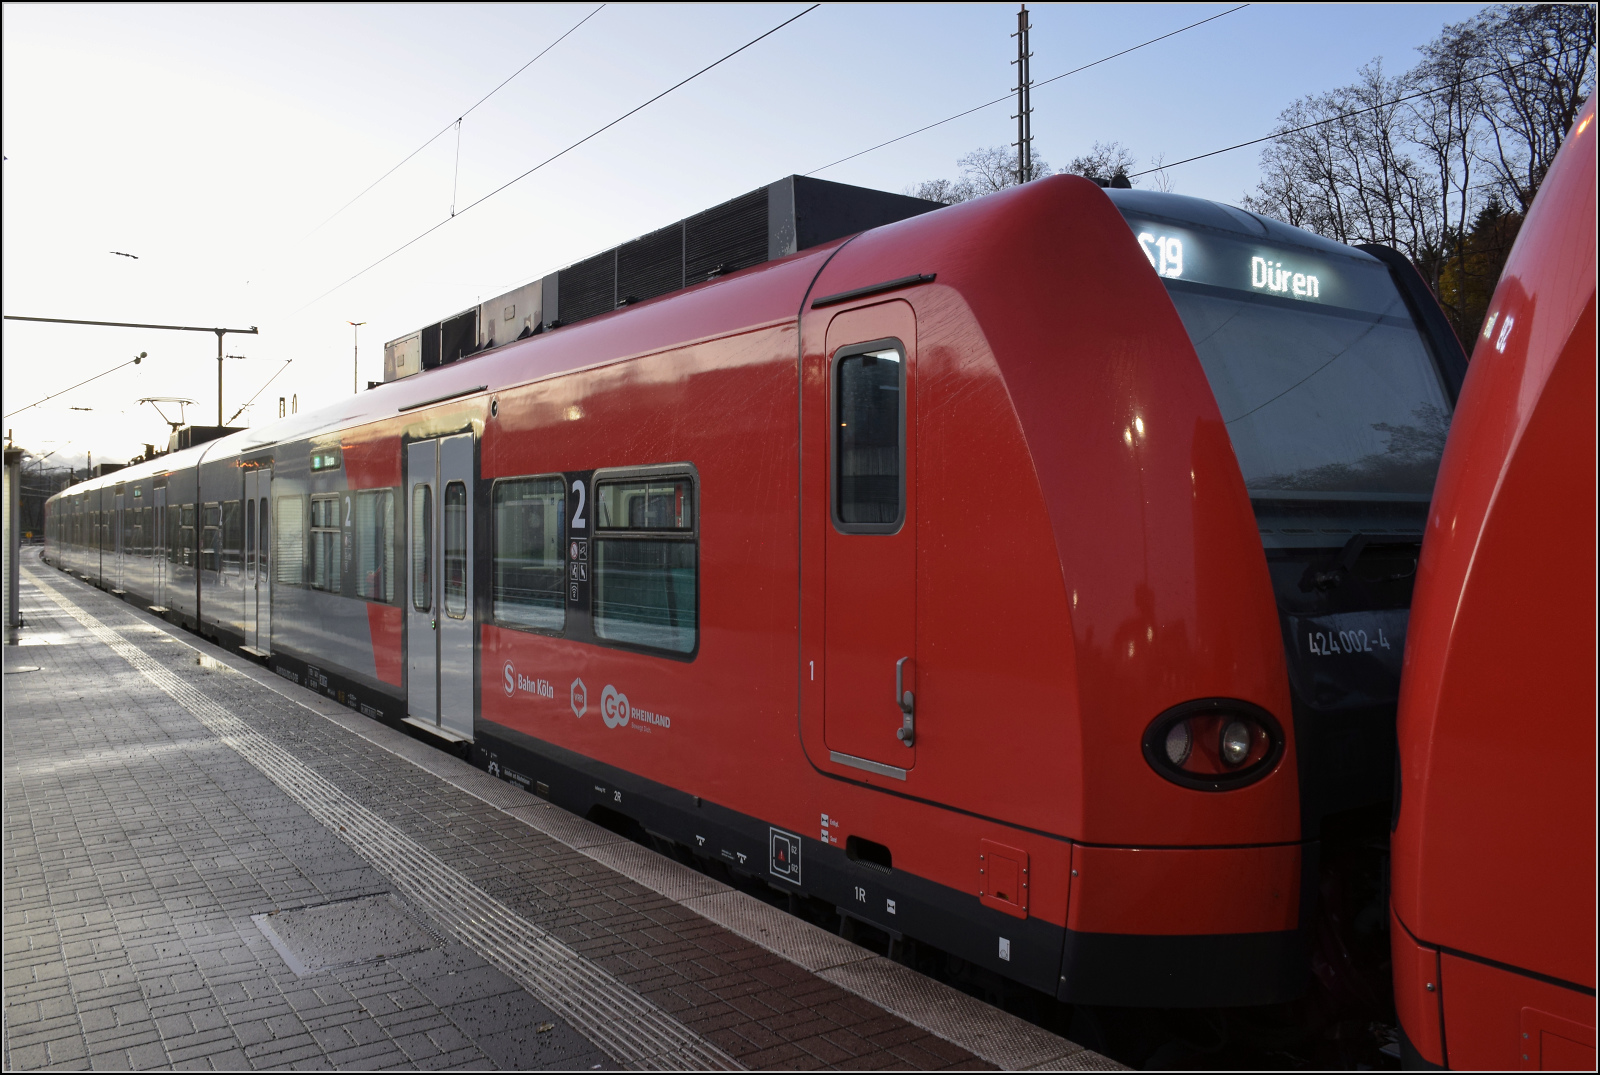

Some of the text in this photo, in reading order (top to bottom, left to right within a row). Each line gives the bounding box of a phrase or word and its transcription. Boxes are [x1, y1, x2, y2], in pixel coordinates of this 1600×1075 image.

[1251, 256, 1319, 297] Düren
[344, 495, 352, 527] 2
[571, 479, 586, 529] 2
[809, 660, 814, 681] 1
[517, 673, 536, 694] Bahn
[536, 679, 554, 699] Köln
[631, 707, 671, 729] RHEINLAND
[613, 790, 622, 803] 2R
[854, 886, 866, 903] 1R
